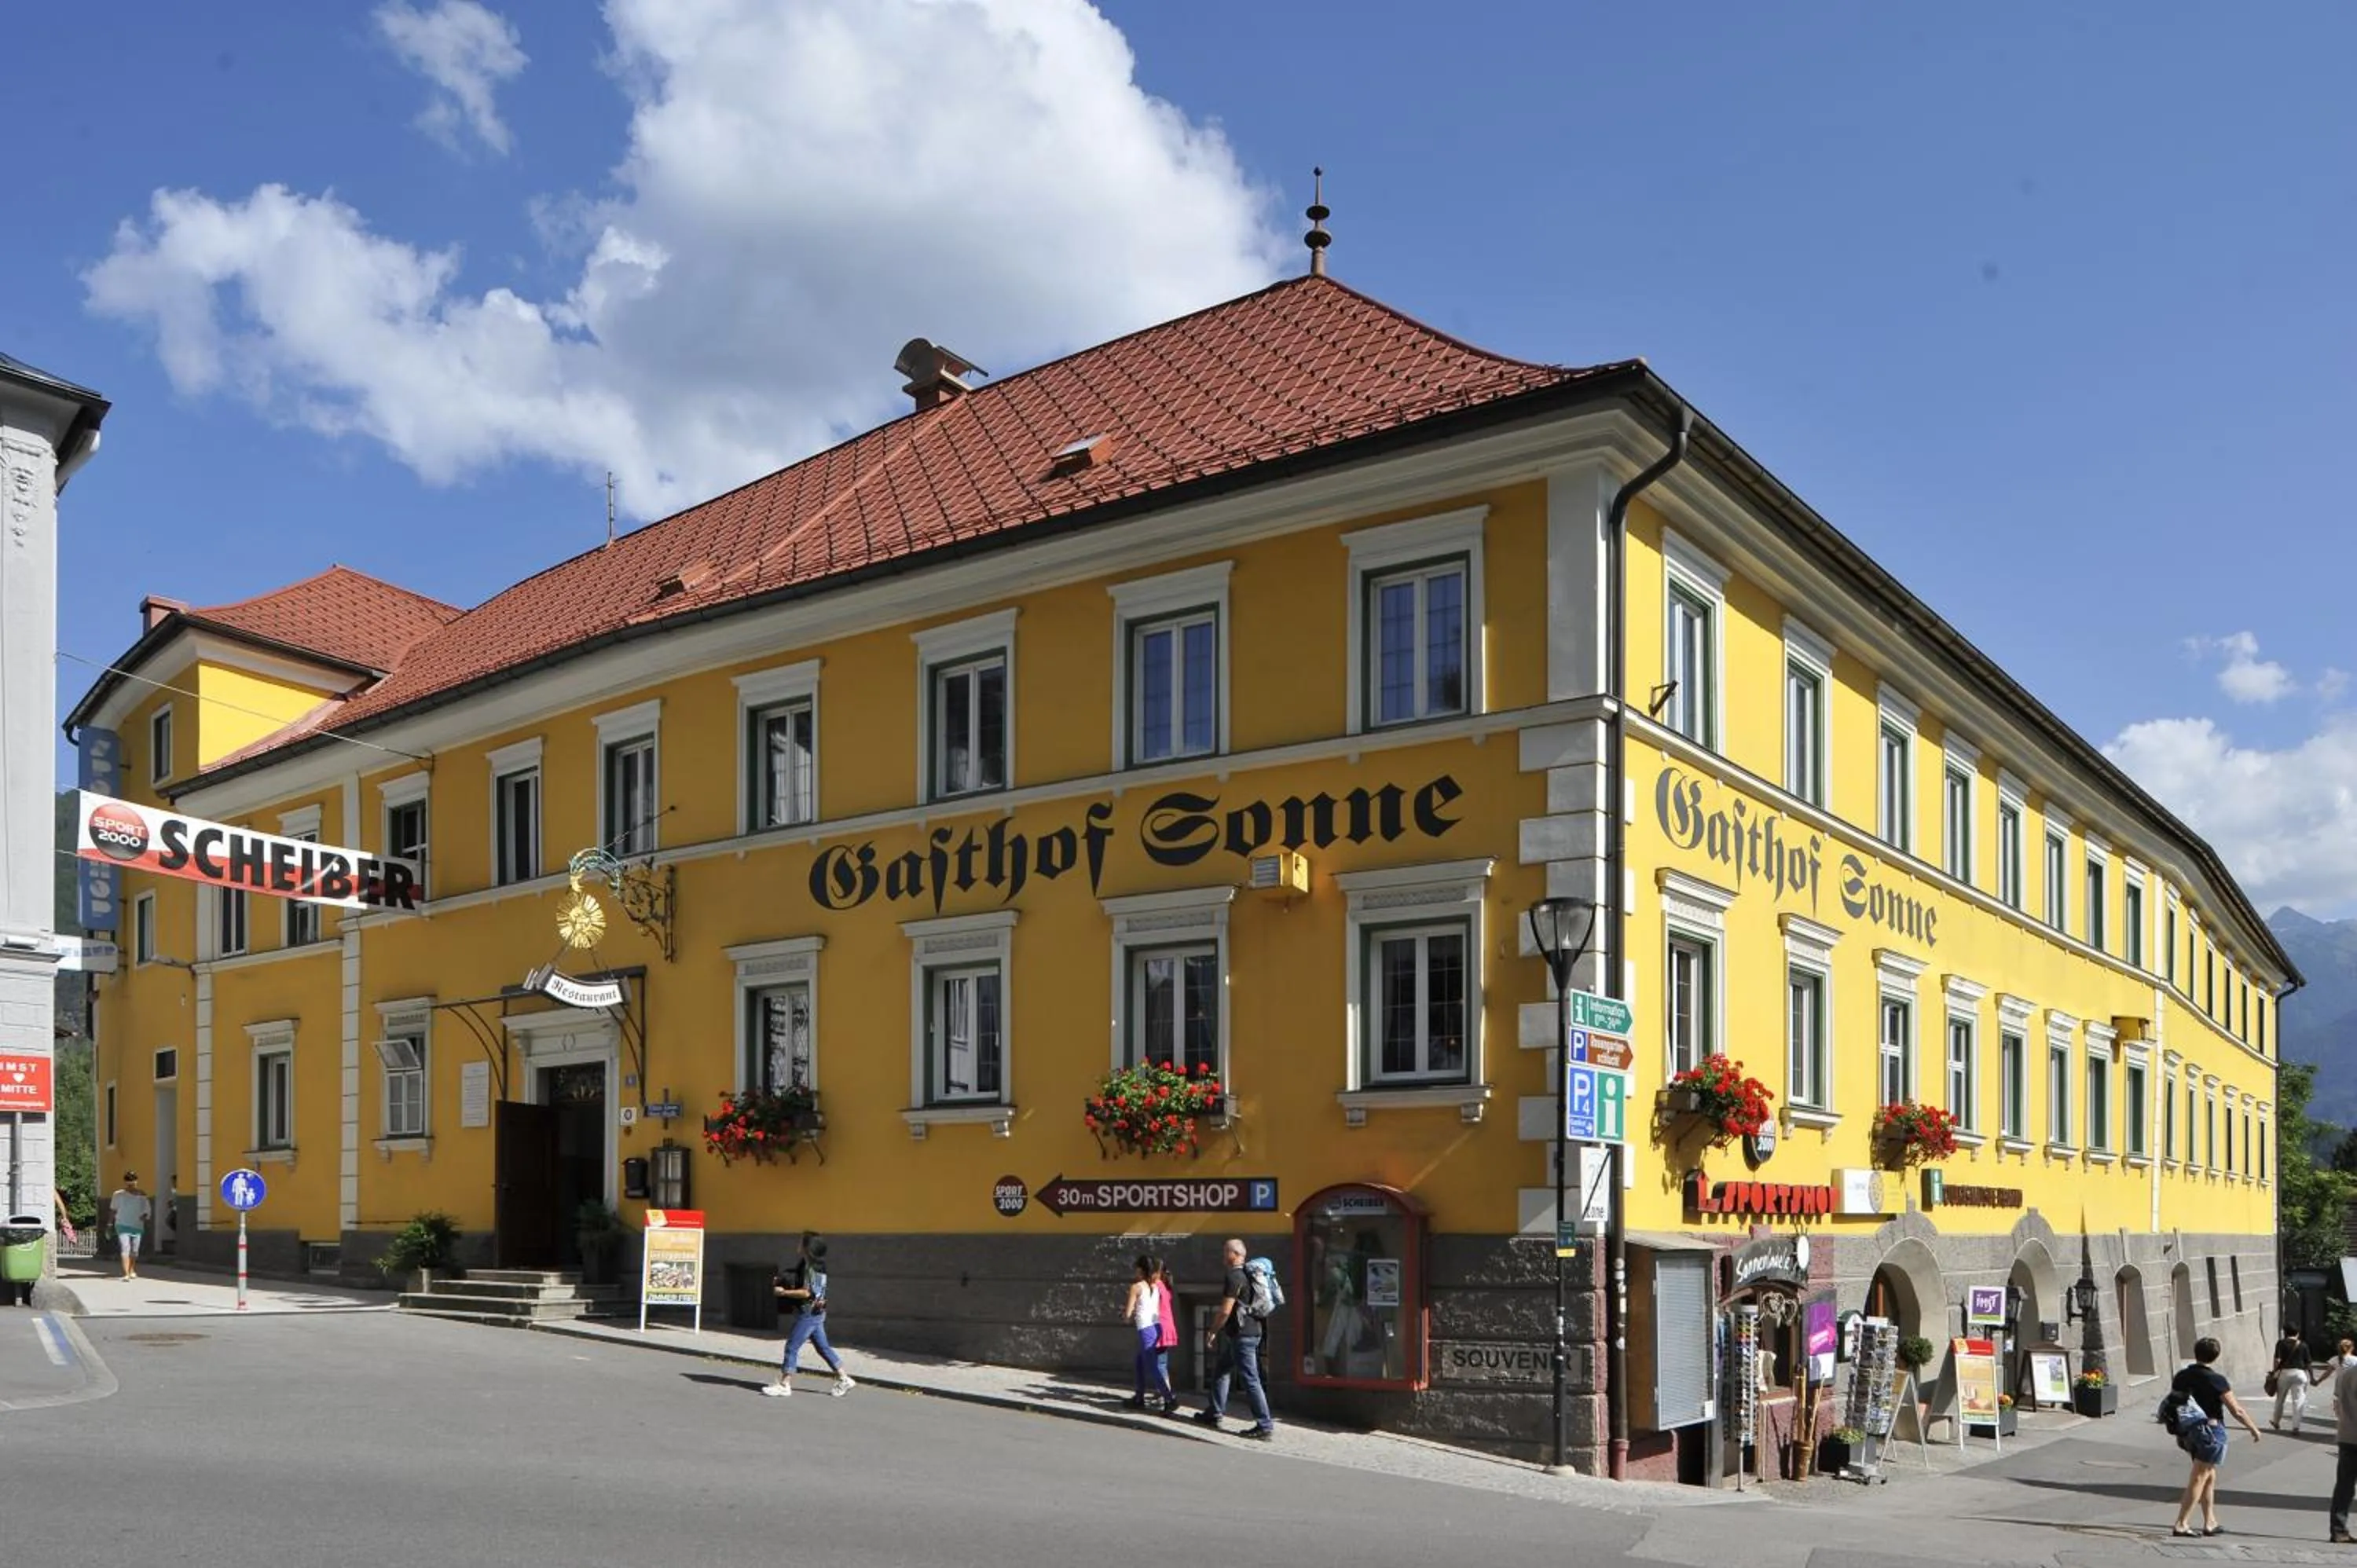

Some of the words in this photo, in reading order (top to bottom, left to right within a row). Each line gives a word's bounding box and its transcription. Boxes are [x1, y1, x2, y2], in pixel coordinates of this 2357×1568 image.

[93, 816, 146, 837] SPORT
[1138, 774, 1464, 867] Sonne
[97, 829, 141, 848] 2000
[159, 819, 416, 910] SCHEIBER
[1839, 854, 1937, 947] Sonne
[551, 978, 617, 1002] Restaurant
[1573, 1031, 1585, 1060] P
[0, 1084, 38, 1095] MITTE
[995, 1185, 1023, 1197] SPORT
[1097, 1184, 1238, 1207] SPORTSHOP
[1256, 1184, 1270, 1206] P
[1722, 1181, 1839, 1215] SPORTSHOP
[999, 1198, 1024, 1210] 2000
[1453, 1349, 1572, 1370] SOUVENR
